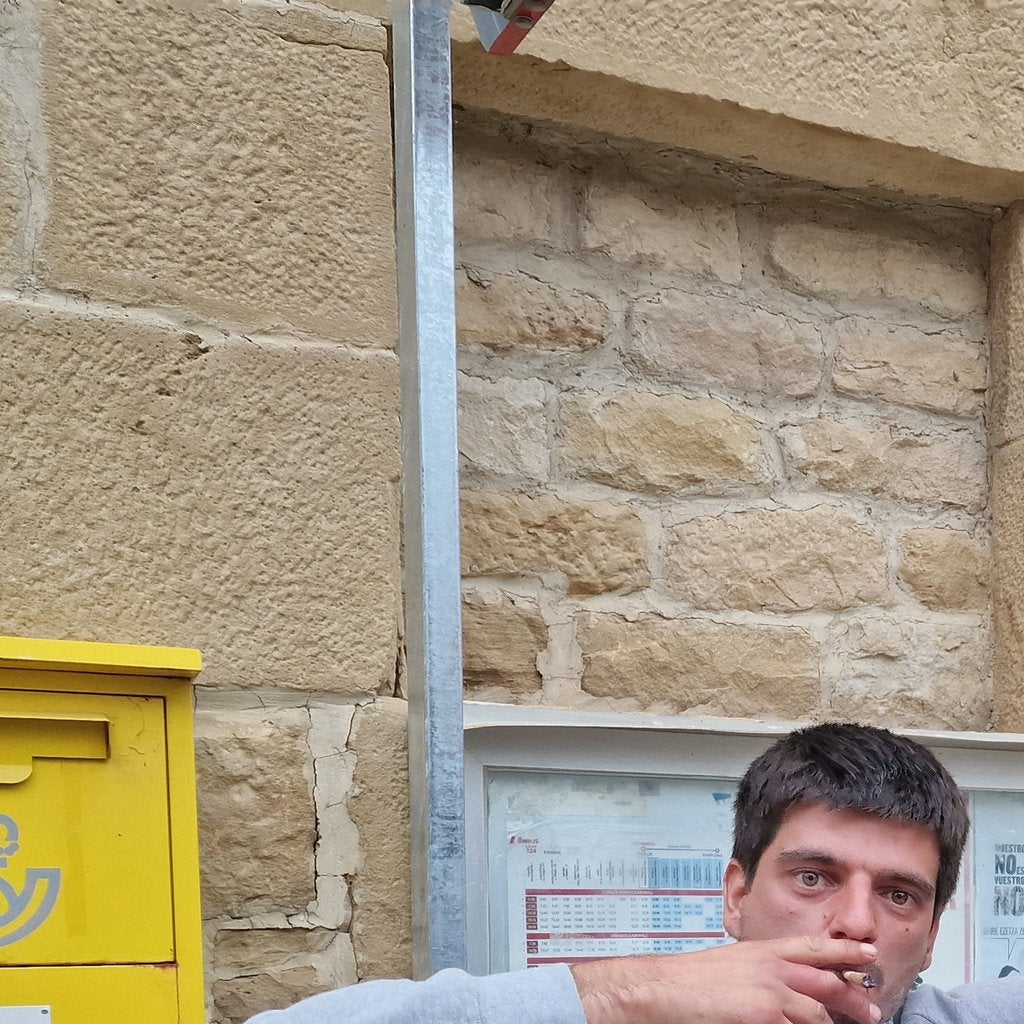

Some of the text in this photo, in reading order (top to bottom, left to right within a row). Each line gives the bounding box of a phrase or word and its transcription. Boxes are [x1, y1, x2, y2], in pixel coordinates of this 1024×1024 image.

[995, 854, 1024, 875] NO ES
[994, 876, 1024, 885] VUESTRO
[994, 886, 1024, 916] NO
